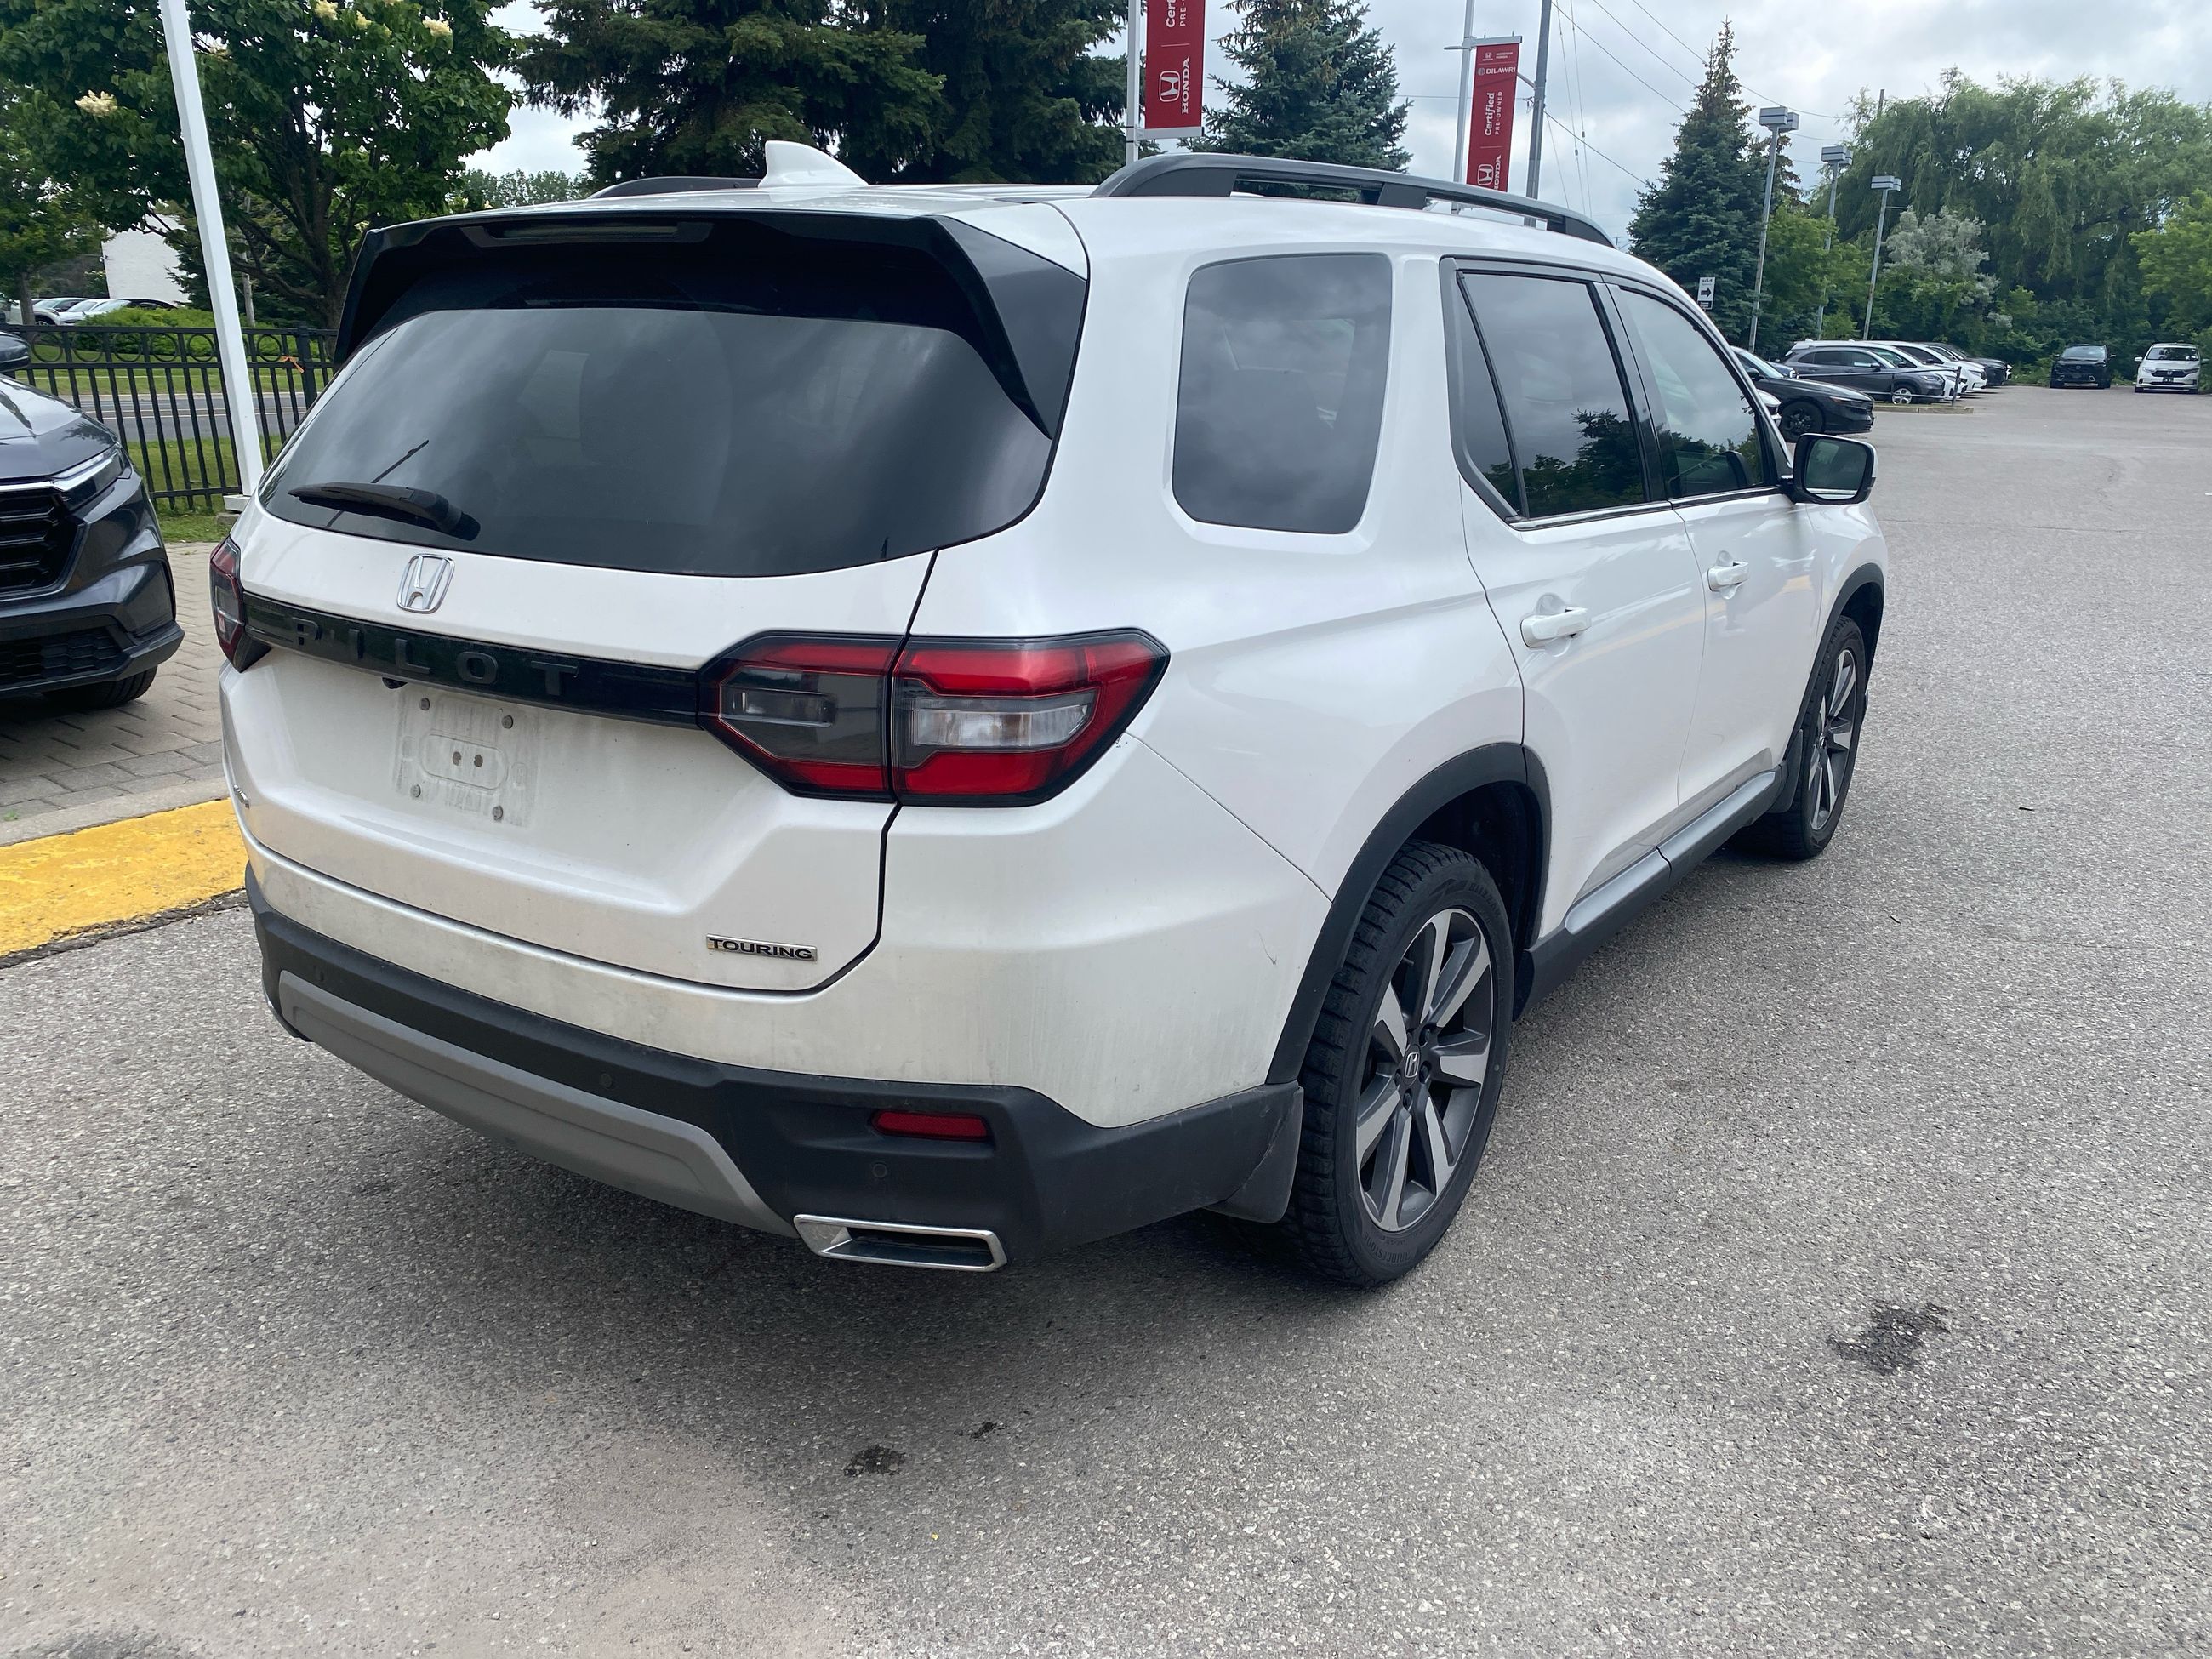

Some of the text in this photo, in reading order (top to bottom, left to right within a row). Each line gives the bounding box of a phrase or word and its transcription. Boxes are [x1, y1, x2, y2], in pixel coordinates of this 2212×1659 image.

[1181, 56, 1190, 115] HONDA
[1485, 66, 1517, 75] DILAWRI
[1485, 92, 1496, 136] Certified
[1495, 91, 1503, 135] PRE-OWNED
[291, 616, 579, 696] PILOT
[709, 938, 812, 960] TOURING
